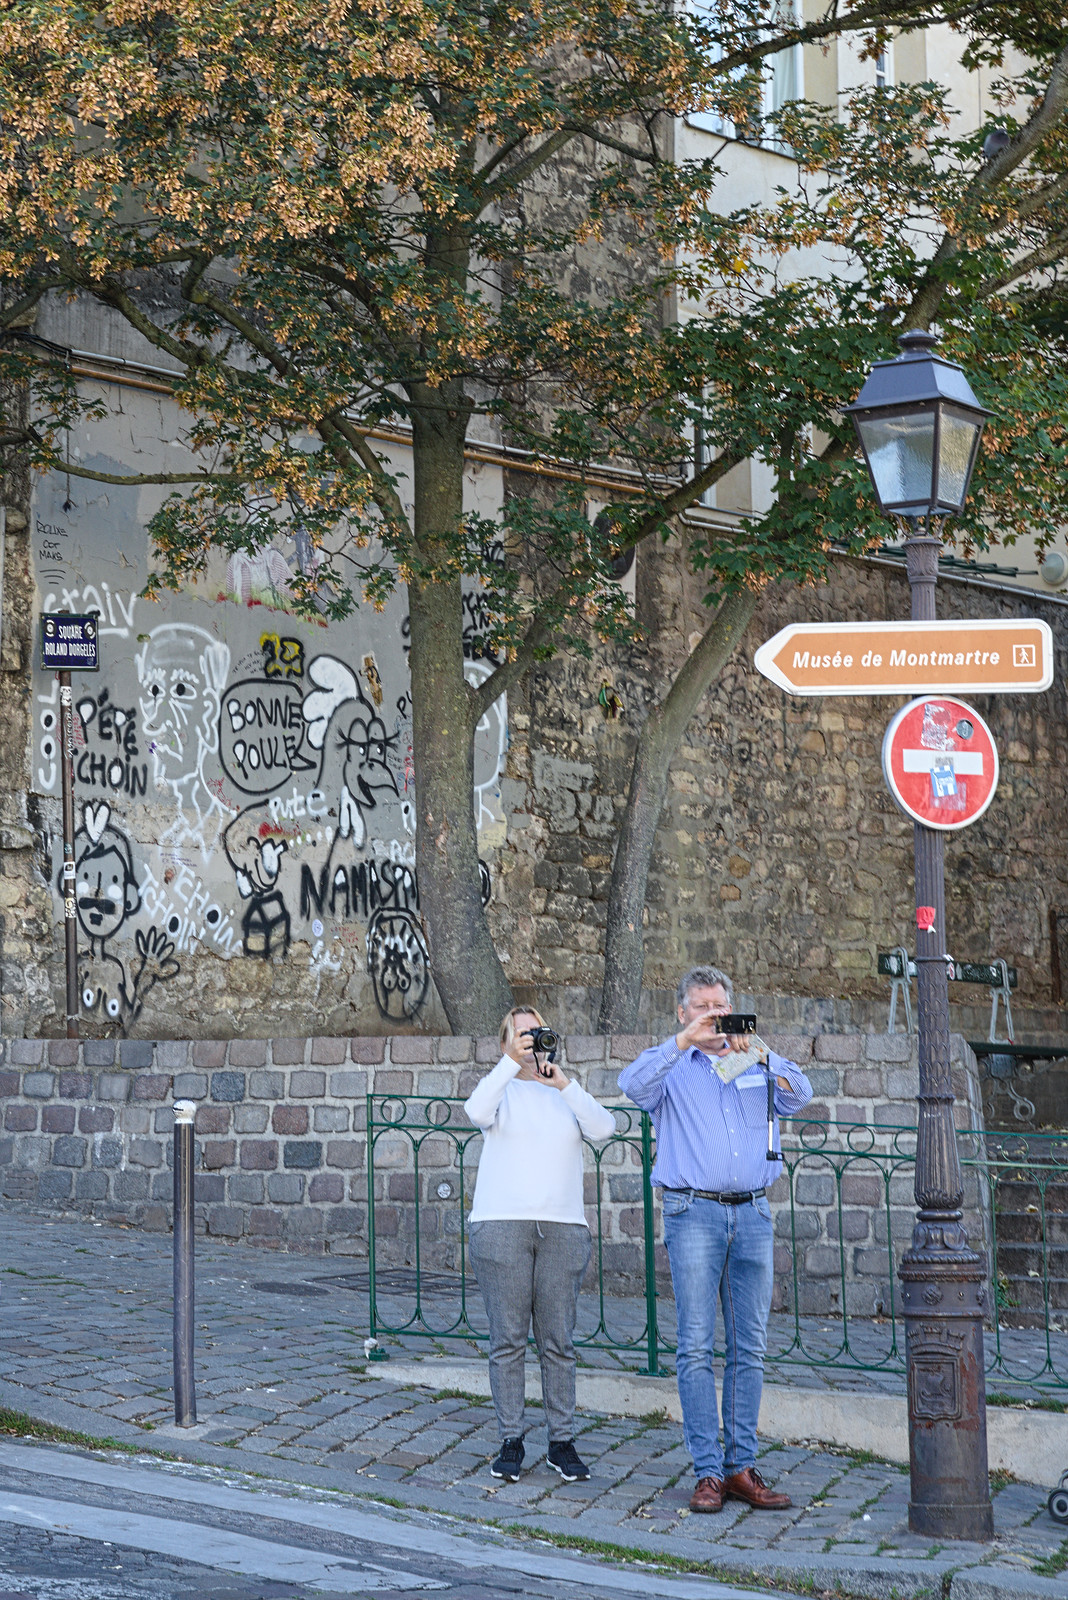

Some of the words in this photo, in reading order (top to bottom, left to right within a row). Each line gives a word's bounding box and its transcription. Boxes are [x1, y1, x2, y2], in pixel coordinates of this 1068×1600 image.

[58, 625, 83, 640] SQUARE
[44, 642, 68, 656] ROLAND
[793, 651, 853, 669] Musée
[861, 651, 883, 668] de
[889, 649, 1000, 668] Montmartre
[226, 695, 302, 734] BONNE
[231, 734, 299, 780] POULE
